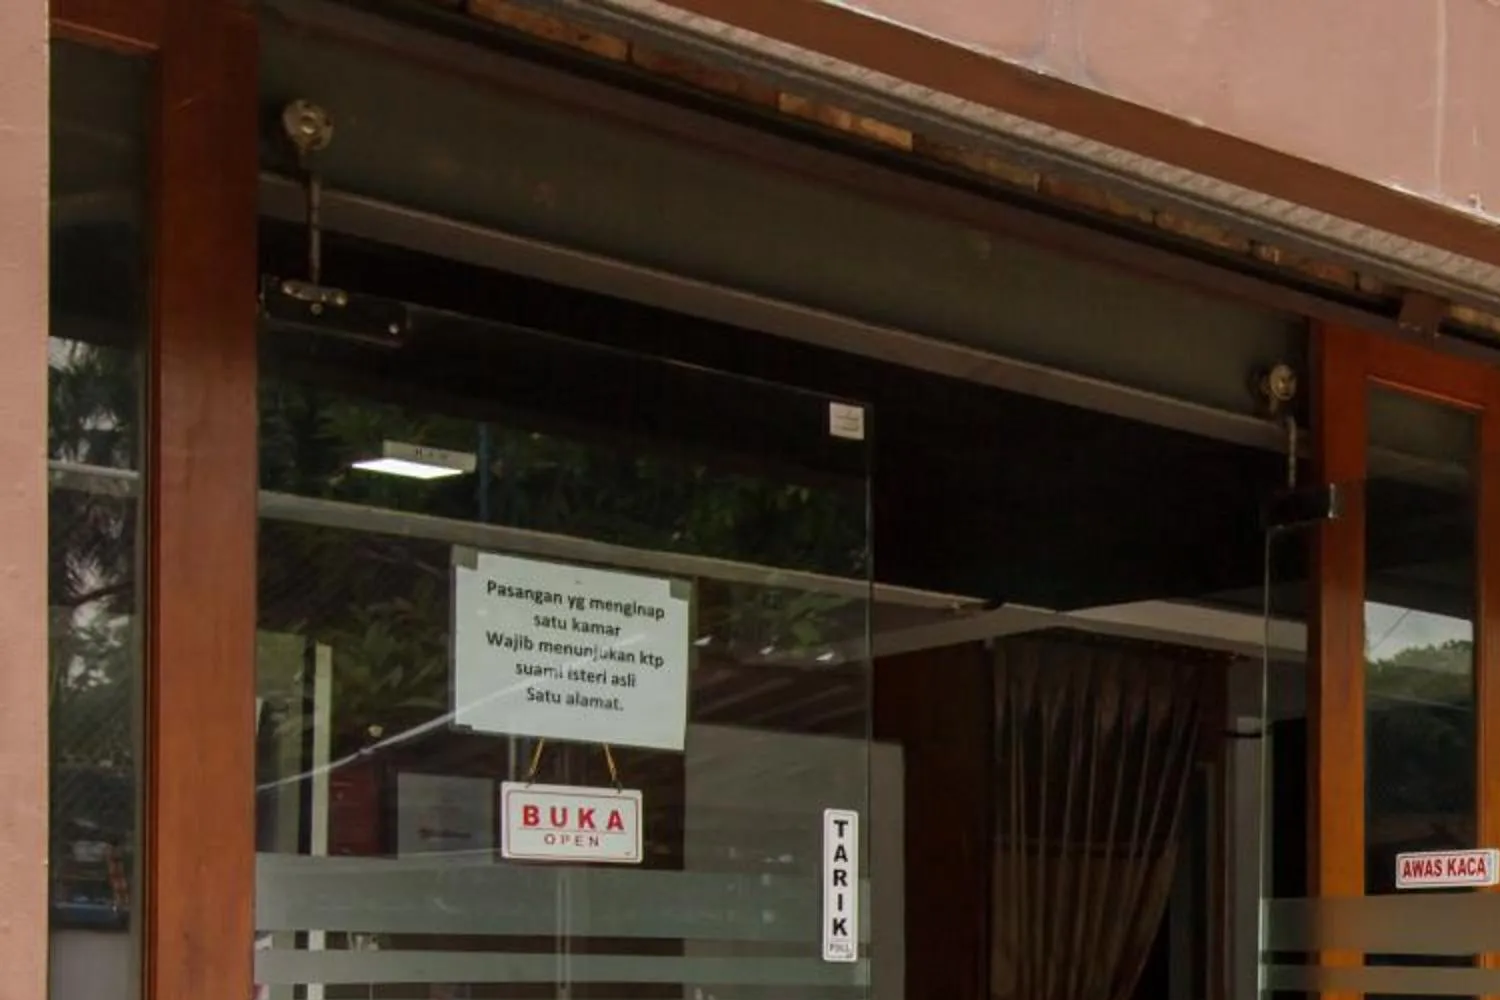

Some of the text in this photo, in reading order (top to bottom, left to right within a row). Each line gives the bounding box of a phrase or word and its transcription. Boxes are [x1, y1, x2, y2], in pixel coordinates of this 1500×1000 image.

[487, 579, 665, 622] Pasangan yg menginap
[533, 611, 622, 637] satu kamar
[486, 630, 665, 670] Wajib menunjukan ktp
[515, 662, 636, 688] suami isteri asli
[527, 687, 624, 712] Satu alamat.
[522, 805, 624, 831] BUKA
[544, 833, 600, 847] OPEN
[832, 819, 849, 937] TARIK
[1403, 858, 1487, 877] AWAS KACA
